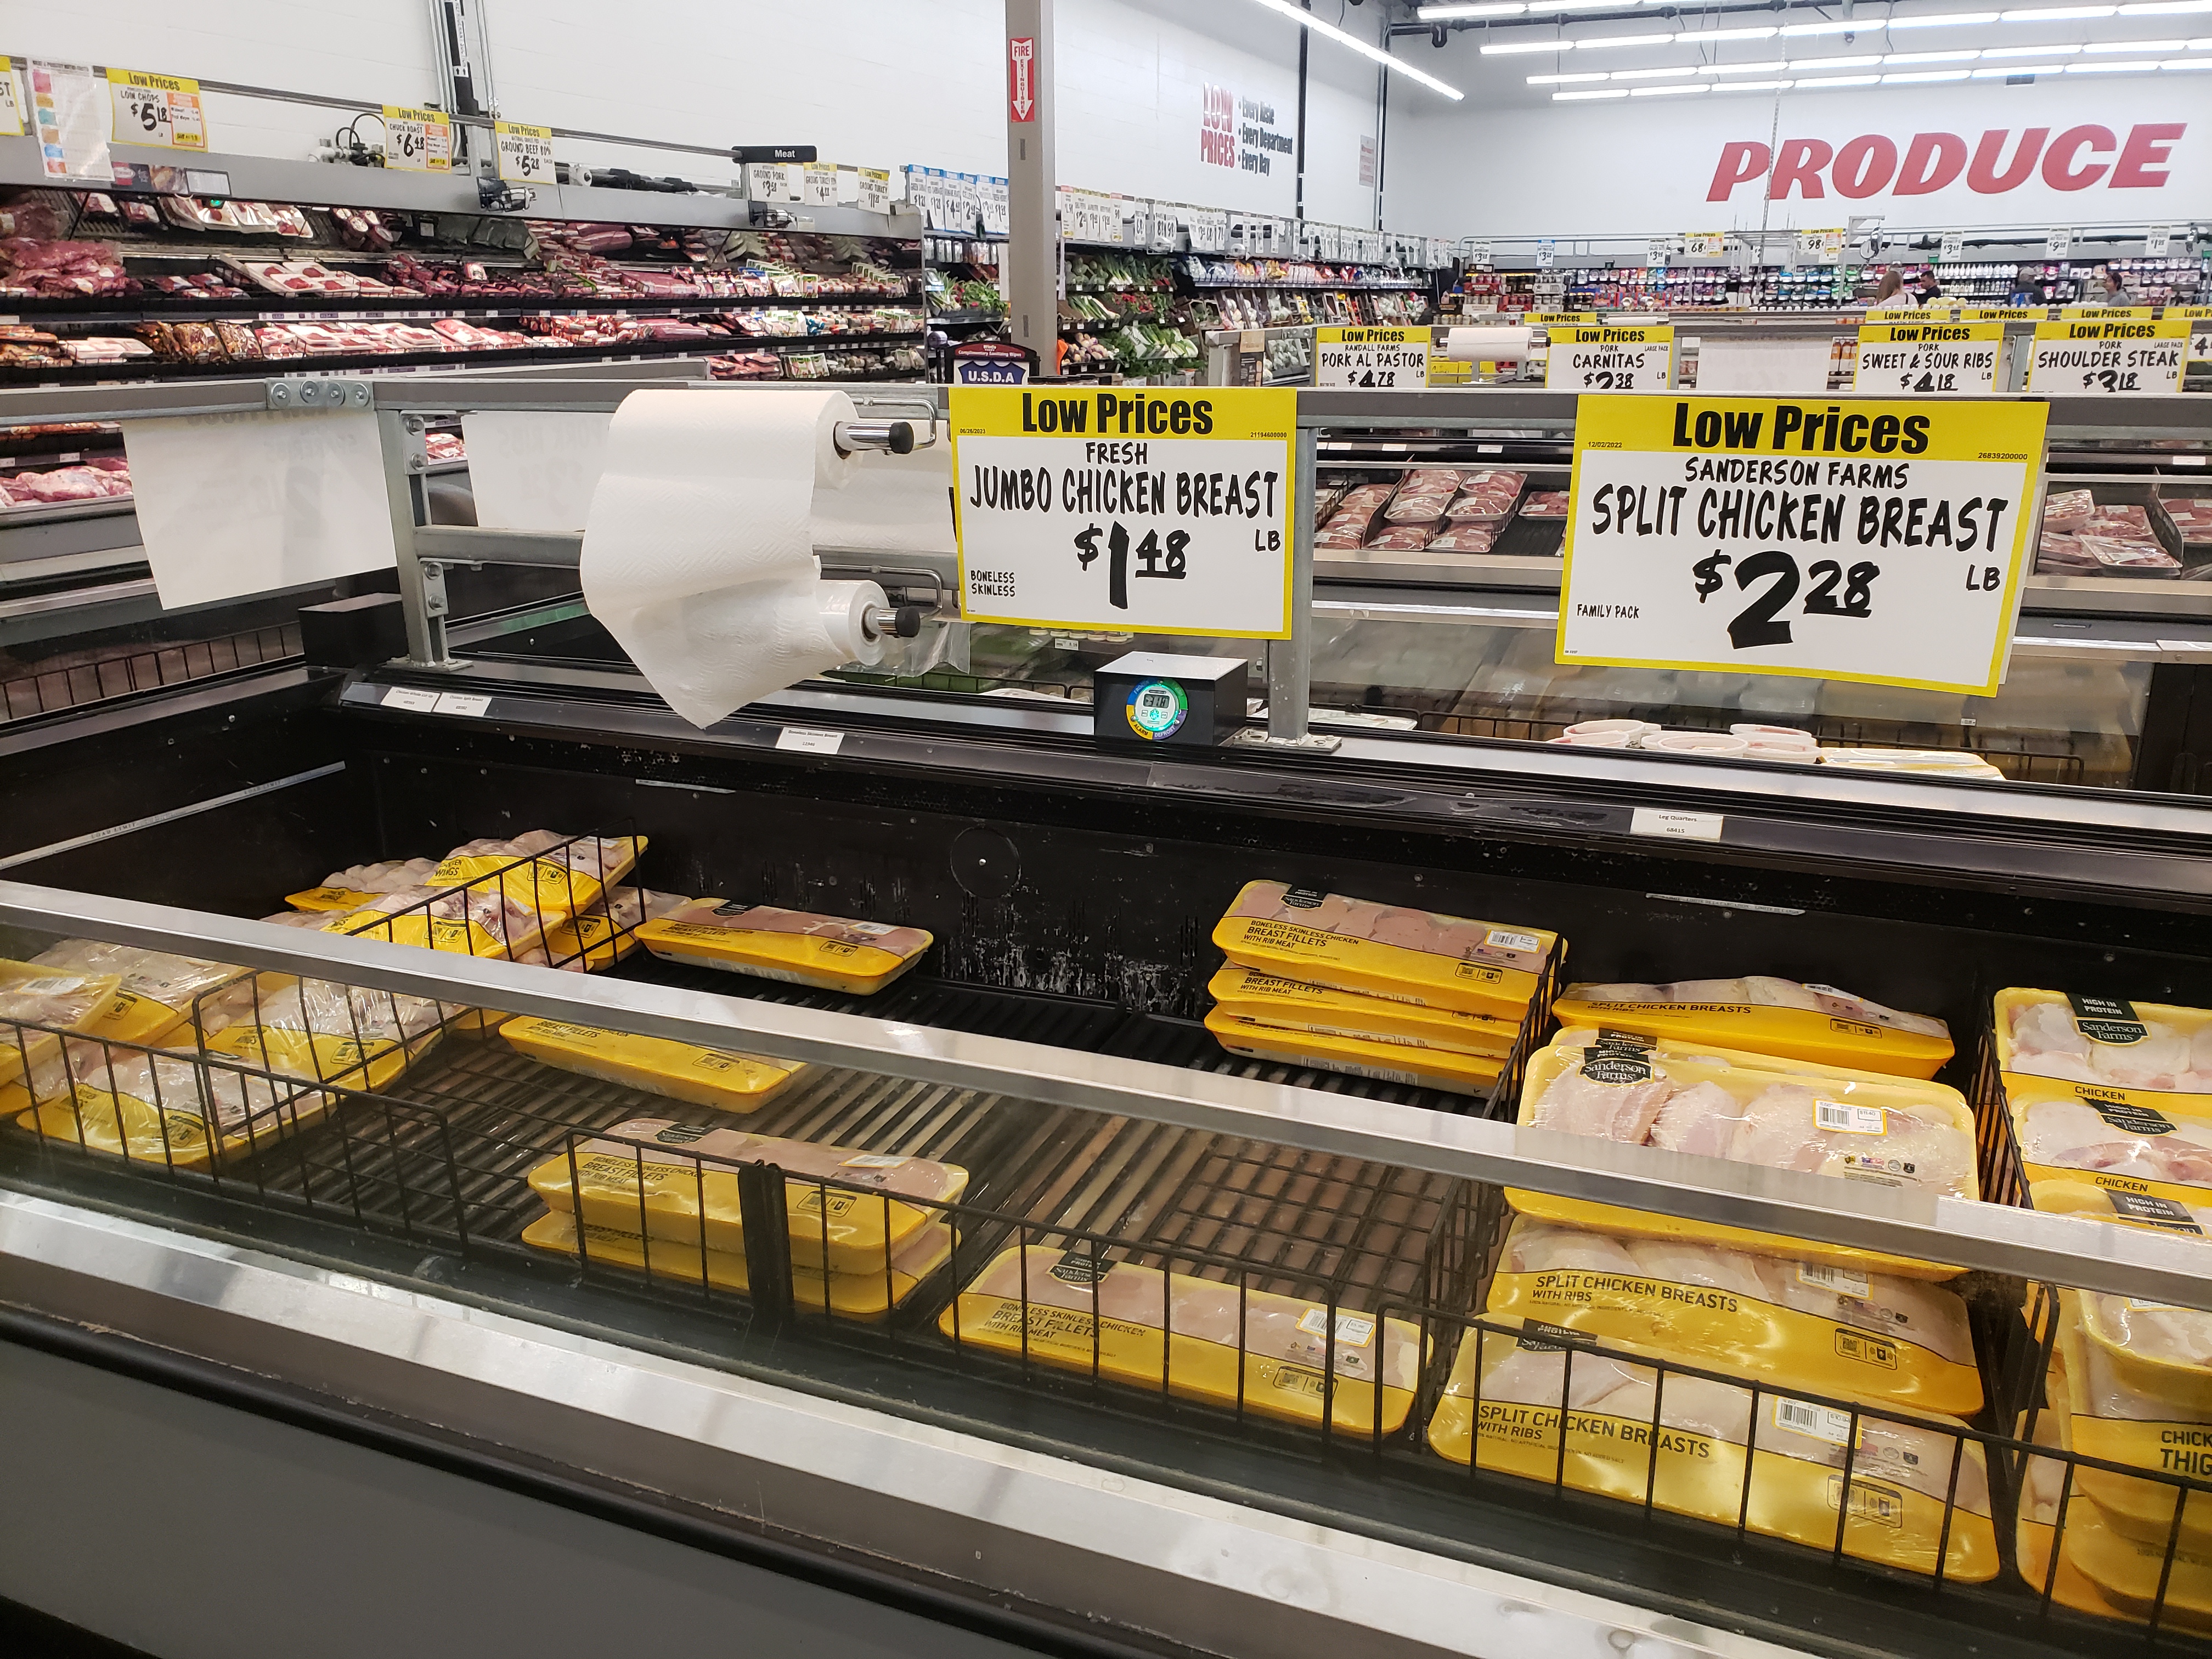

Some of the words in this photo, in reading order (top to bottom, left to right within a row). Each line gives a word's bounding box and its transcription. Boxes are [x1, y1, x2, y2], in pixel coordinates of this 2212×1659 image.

[1014, 45, 1030, 57] FIRE
[128, 72, 148, 86] Low
[149, 75, 180, 91] Prices
[138, 93, 160, 103] CHOPS
[1203, 82, 1234, 133] LOW
[398, 108, 411, 119] Low
[413, 109, 435, 122] Prices
[389, 123, 405, 132] CHUCK
[407, 125, 423, 134] ROAST
[508, 124, 520, 134] Low
[520, 126, 540, 137] Prices
[1242, 122, 1259, 149] Every
[1260, 127, 1293, 155] Department
[501, 140, 523, 153] GROUND
[525, 144, 538, 155] BEEF
[775, 149, 795, 158] Meat
[1200, 128, 1235, 168] PRICES
[1242, 149, 1259, 174] Every
[1259, 153, 1271, 177] Day
[1706, 122, 2188, 202] PRODUCE
[753, 170, 771, 179] GROUND
[772, 171, 785, 180] PORK
[1540, 313, 1554, 323] Low
[1556, 313, 1581, 323] Prices
[1884, 311, 1901, 320] Low
[1903, 311, 1931, 320] Prices
[1979, 310, 1997, 319] Low
[1999, 309, 2028, 319] Prices
[2081, 309, 2100, 318] Low
[2101, 309, 2132, 318] Prices
[2184, 309, 2203, 318] Low
[1341, 329, 1364, 342] Low
[1367, 329, 1405, 342] Prices
[1576, 329, 1600, 342] Low
[1602, 328, 1645, 342] Prices
[1889, 328, 1919, 341] Low
[1921, 326, 1971, 341] Prices
[2069, 323, 2101, 338] Low
[2103, 323, 2155, 338] Prices
[1600, 345, 1619, 353] PORK
[1918, 343, 1940, 352] PORK
[2099, 341, 2123, 349] PORK
[1322, 352, 1352, 368] PORK
[1356, 353, 1372, 367] AL
[1377, 353, 1424, 368] PASTOR
[1573, 353, 1645, 369] CARNITAS
[1862, 353, 1906, 370] SWEET
[1909, 353, 1921, 369] &
[1925, 352, 1959, 370] SOUR
[1963, 351, 1994, 369] RIBS
[2038, 351, 2121, 369] SHOULDER
[2127, 350, 2179, 368] STEAK
[1657, 371, 1666, 380] LB
[1981, 371, 1993, 380] LB
[2166, 370, 2178, 380] LB
[1022, 392, 1088, 433] Low
[1097, 392, 1214, 435] Prices
[1672, 402, 1764, 449] Low
[1772, 404, 1932, 455] Prices
[1085, 441, 1148, 465] FRESH
[1977, 452, 2028, 461] 26839200000
[1685, 456, 1820, 487] SANDERSON
[1827, 461, 1910, 490] FARMS
[970, 465, 1052, 514] JUMBO
[1062, 467, 1166, 516] CHICKEN
[1176, 470, 1279, 518] BREAST
[1592, 483, 1688, 537] SPLIT
[1697, 490, 1846, 545] CHICKEN
[1857, 495, 2008, 553] BREAST
[1254, 528, 1281, 552] LB
[970, 569, 1015, 584] BONELESS
[1966, 563, 2001, 593] LB
[970, 583, 1016, 597] SKINLESS
[1576, 602, 1612, 619] FAMILY
[1614, 604, 1640, 620] PACK
[1133, 724, 1149, 736] ALARM
[1154, 726, 1176, 738] DEFROST
[1247, 926, 1285, 939] BREAST
[1286, 932, 1327, 947] FILLETS
[1251, 920, 1288, 930] BONELESS
[1289, 926, 1325, 938] SKINLESS
[1325, 932, 1359, 945] CHICKEN
[1243, 934, 1262, 943] WITH
[1276, 940, 1296, 949] MEAT
[1244, 977, 1283, 987] BREAST
[1282, 981, 1324, 994] FILLETS
[2081, 997, 2106, 1007] HIGH
[1689, 1005, 1751, 1014] BREASTS
[2084, 1006, 2123, 1015] PROTEIN
[2083, 1022, 2143, 1034] Sanderson
[2096, 1031, 2134, 1041] Farms
[1584, 1062, 1647, 1075] Sanderson
[1596, 1070, 1634, 1081] Farms
[2075, 1086, 2126, 1101] CHICKEN
[2104, 1103, 2130, 1111] HIGH
[2107, 1107, 2149, 1118] PROTEIN
[2108, 1116, 2172, 1129] Sanderson
[2122, 1123, 2162, 1134] Farms
[582, 1161, 625, 1175] BREAST
[592, 1156, 631, 1169] BONELESS
[2095, 1176, 2149, 1192] CHICKEN
[2125, 1196, 2152, 1207] HIGH
[2154, 1200, 2168, 1209] IN
[2128, 1203, 2175, 1217] PROTEIN
[1532, 1289, 1561, 1300] WITH
[1564, 1291, 1593, 1302] RIBS
[1536, 1274, 1581, 1288] SPLIT
[1583, 1276, 1656, 1296] CHICKEN
[1661, 1285, 1738, 1313] BREASTS
[984, 1320, 1009, 1331] WITH
[1028, 1328, 1057, 1339] MEAT
[1100, 1321, 1146, 1336] CHICKEN
[1479, 1405, 1530, 1425] SPLIT
[1511, 1426, 1543, 1441] RIBS
